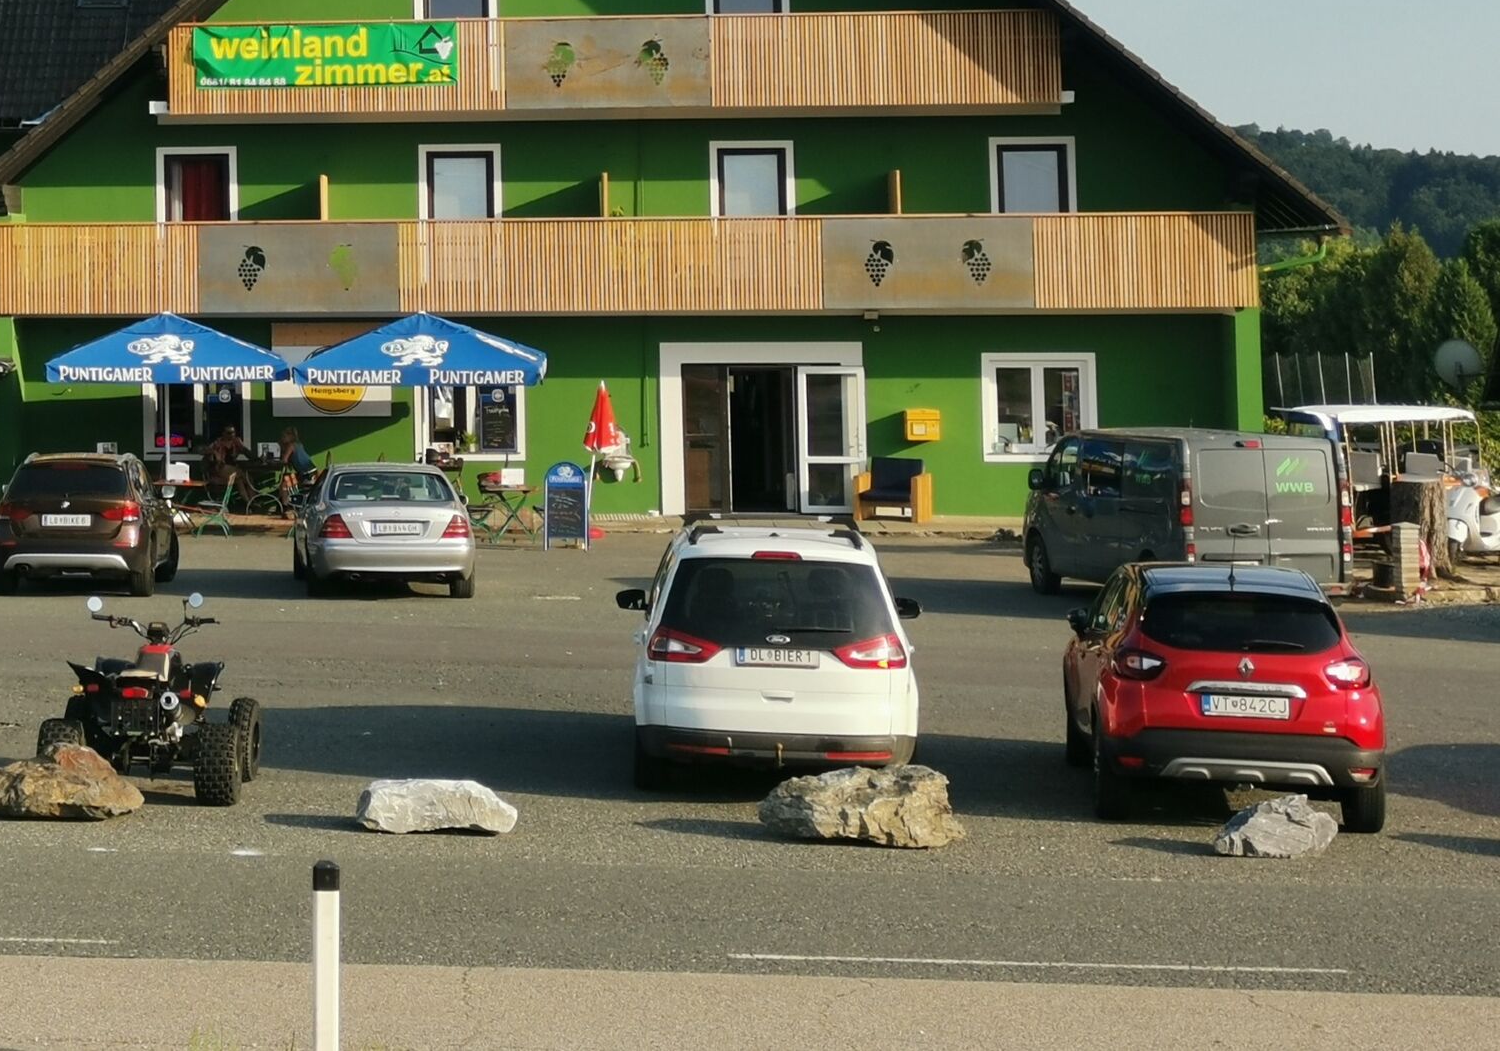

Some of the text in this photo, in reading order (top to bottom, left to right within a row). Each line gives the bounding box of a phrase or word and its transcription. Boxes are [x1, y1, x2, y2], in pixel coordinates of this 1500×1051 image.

[210, 27, 368, 60] weinland
[59, 365, 153, 382] PUNTIGAMER
[180, 365, 273, 382] PUNTIGAMER
[307, 367, 401, 384] PUNTIGAMER
[429, 368, 524, 385] PUNTIGAMER
[1275, 481, 1315, 493] WWB
[750, 649, 812, 663] DL BIER 1
[1212, 696, 1232, 710] VT
[1239, 697, 1288, 714] 842CJ
